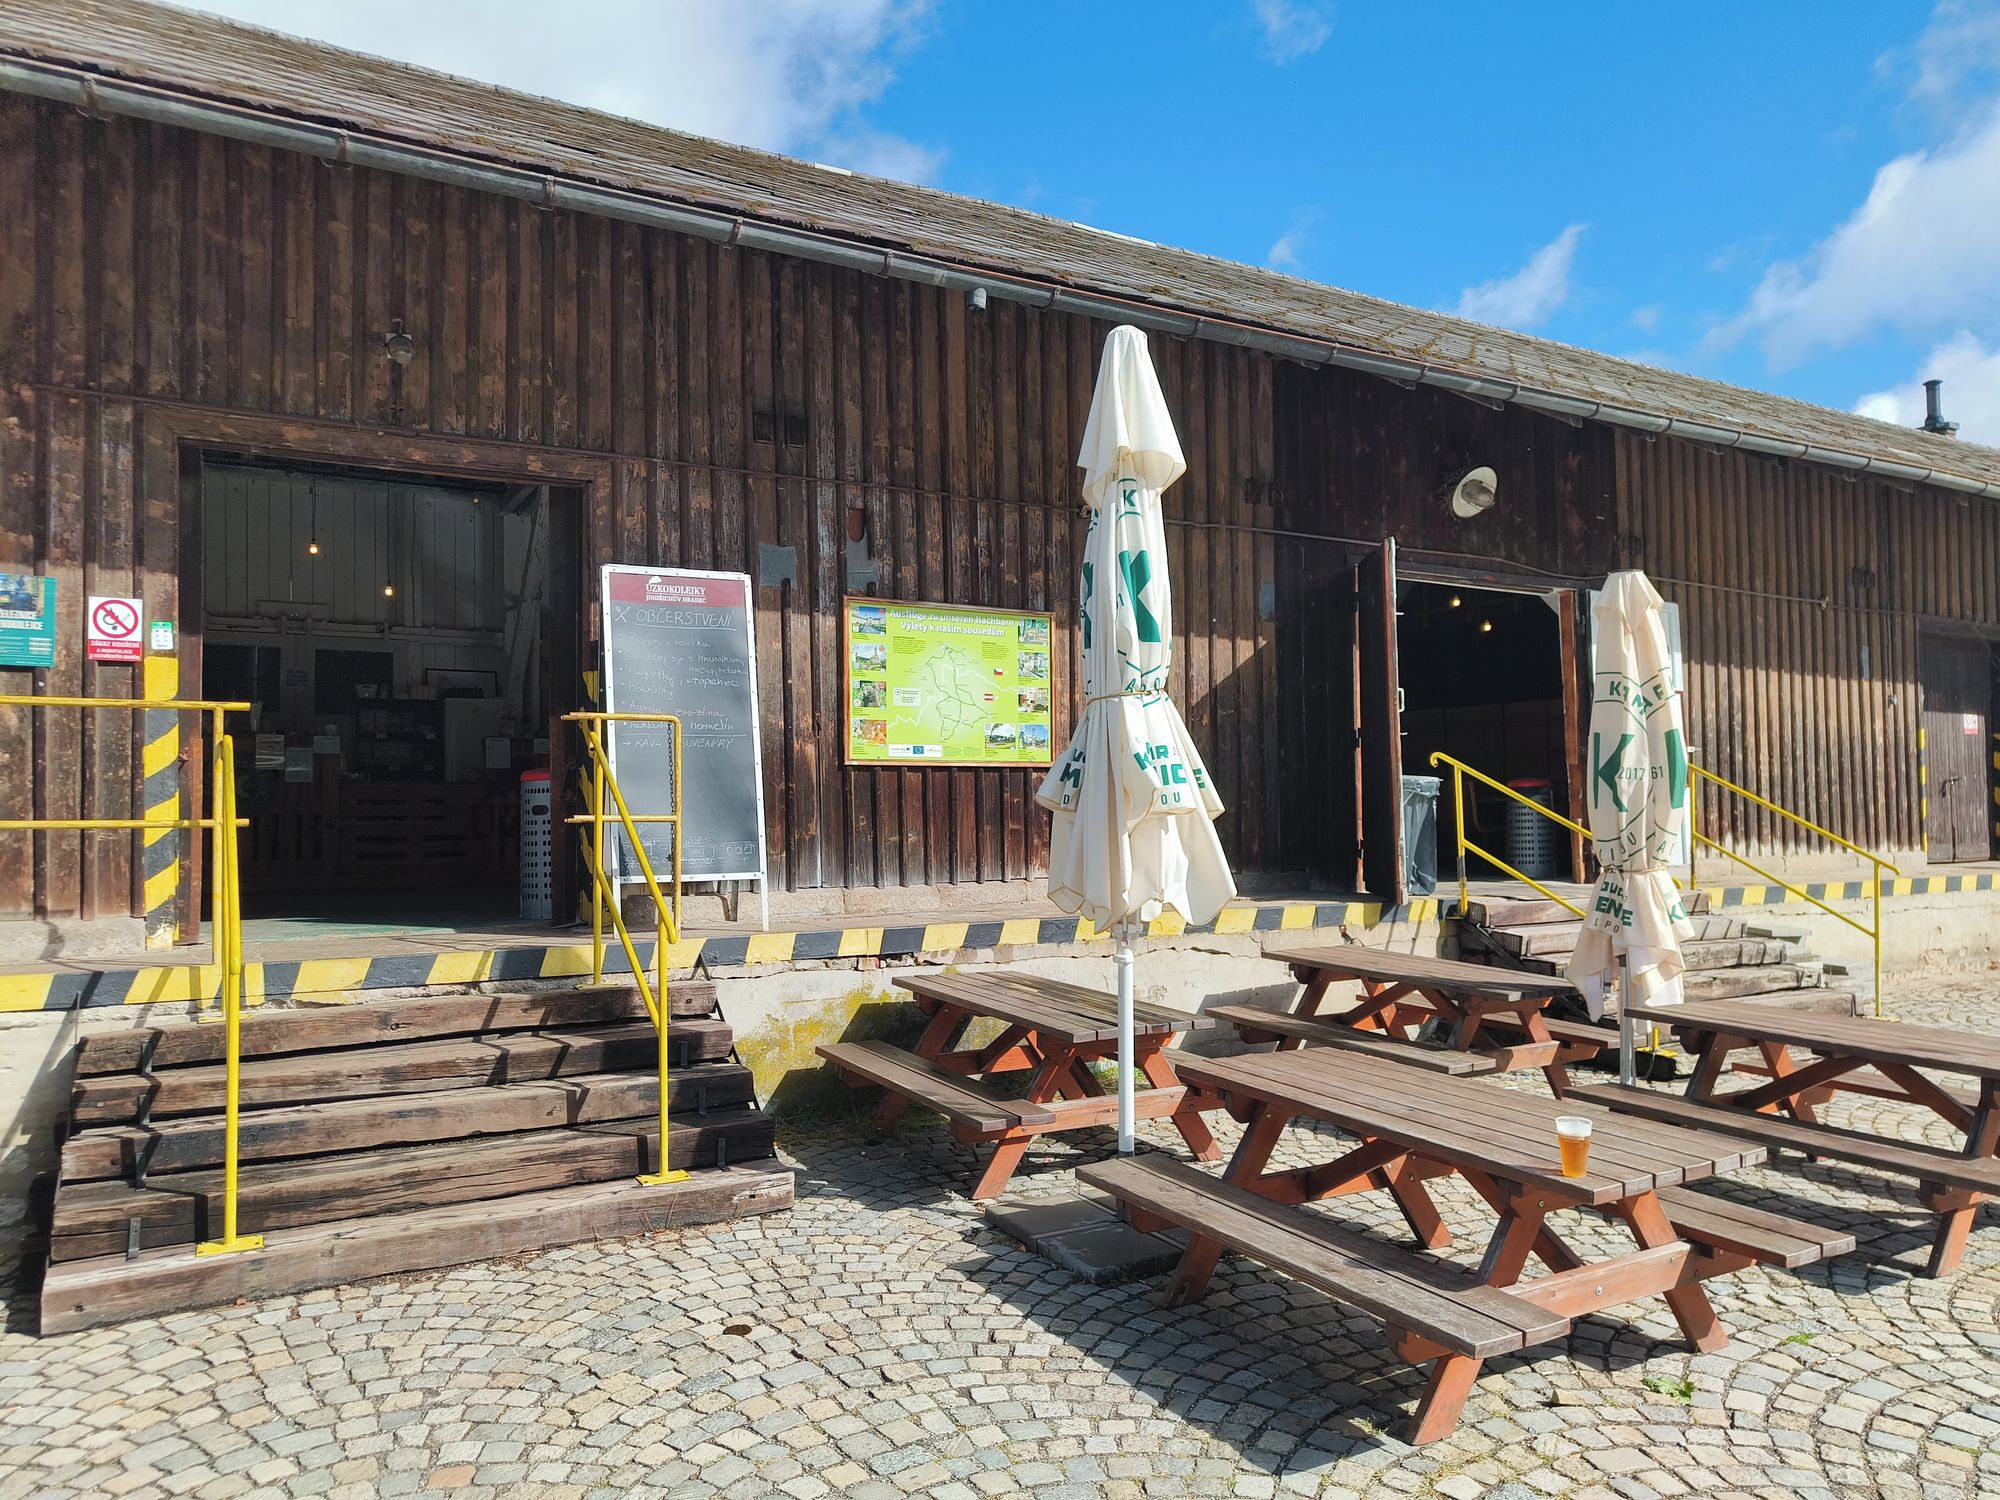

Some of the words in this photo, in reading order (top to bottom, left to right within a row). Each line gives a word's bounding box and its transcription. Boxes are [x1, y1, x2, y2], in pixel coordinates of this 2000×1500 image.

[682, 596, 707, 604] HRADEC
[636, 607, 736, 627] OBČERSTVENÍ
[929, 612, 939, 621] zu
[940, 613, 974, 624] unseren
[975, 615, 1015, 627] Nachbarn
